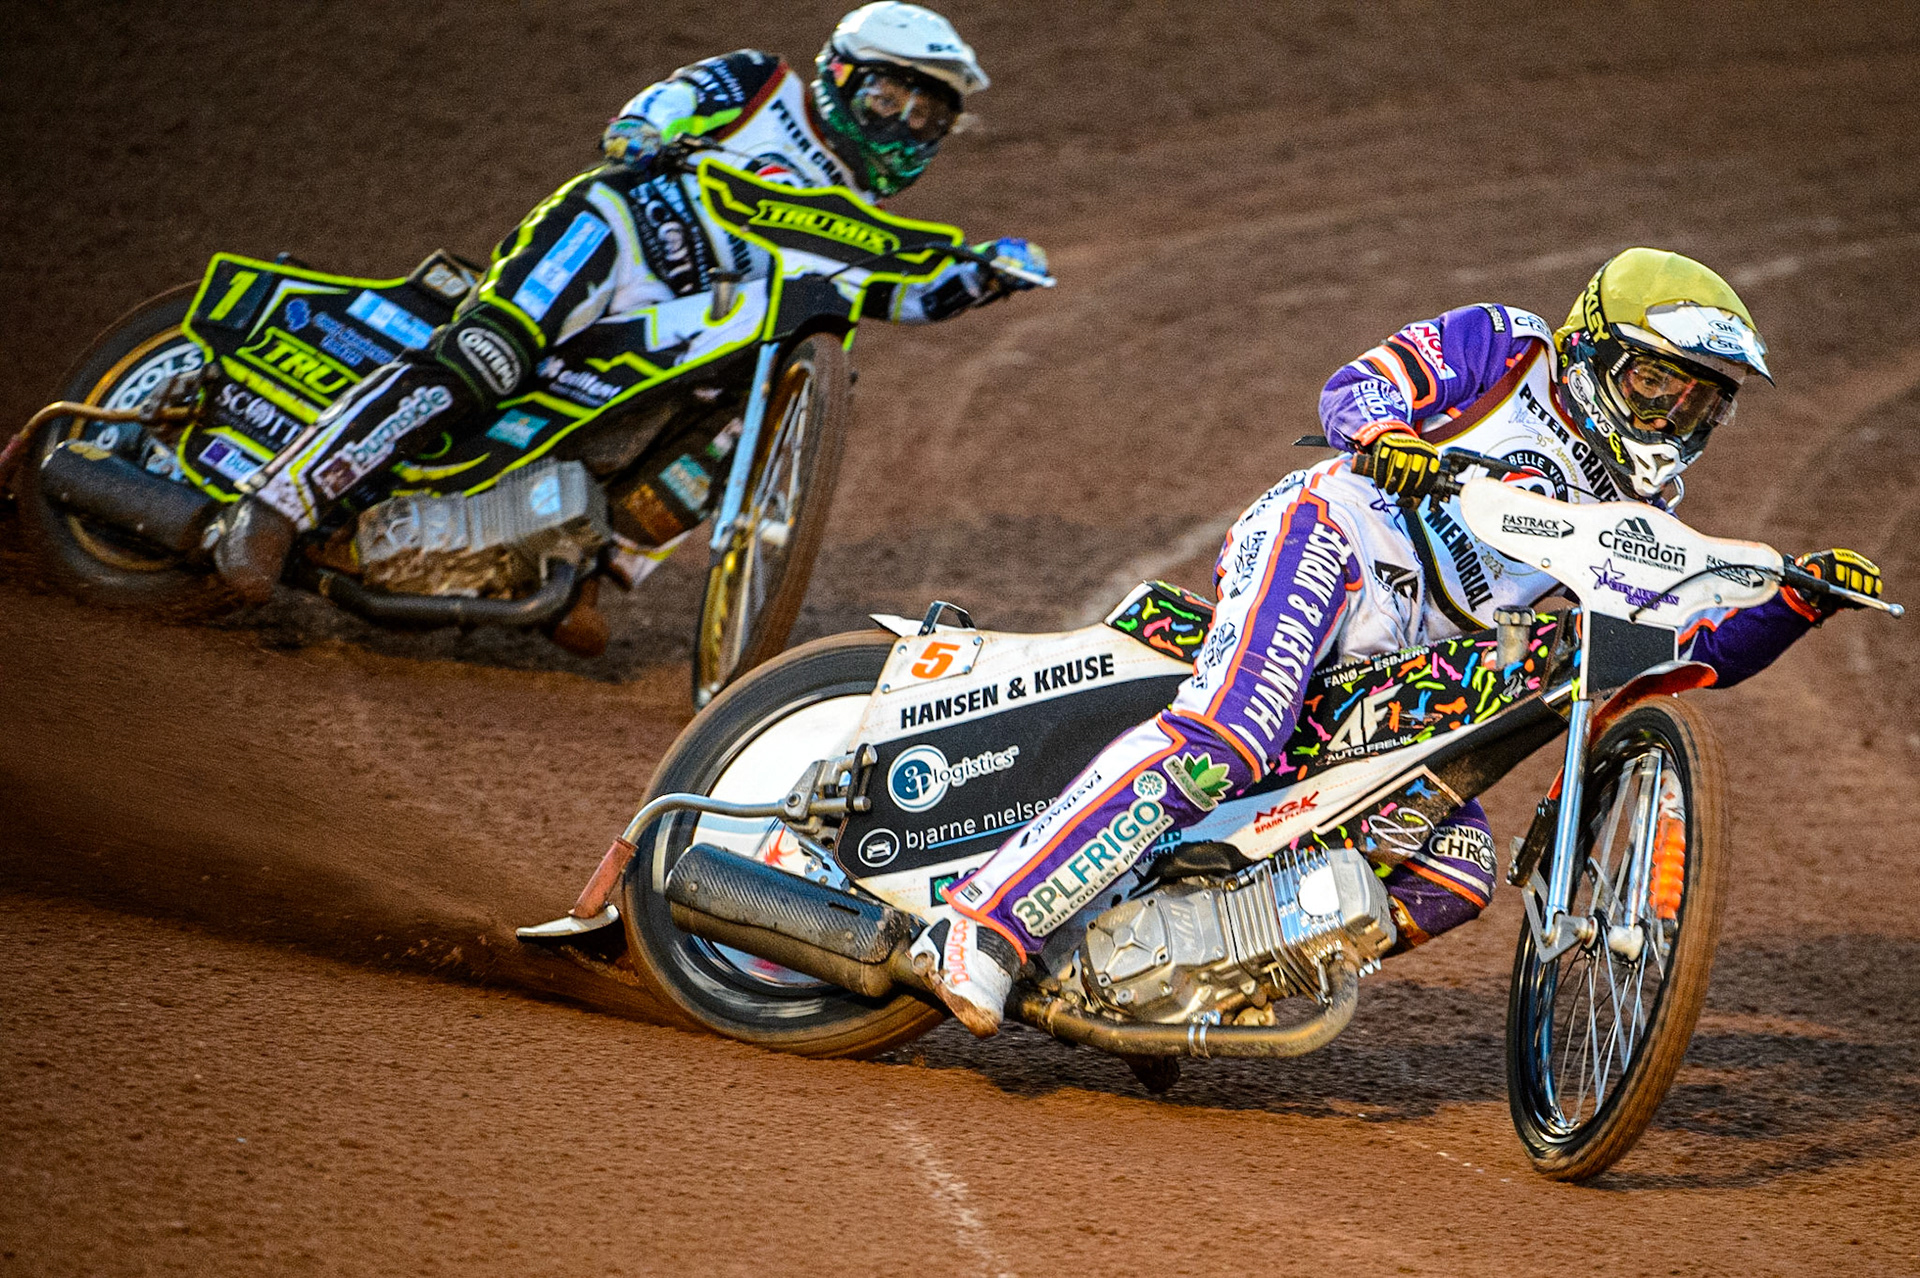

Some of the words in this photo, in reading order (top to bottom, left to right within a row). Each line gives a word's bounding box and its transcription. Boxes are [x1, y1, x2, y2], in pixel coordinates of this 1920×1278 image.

[208, 270, 259, 321] 1
[264, 340, 350, 394] TRU
[1518, 382, 1571, 445] PETER
[1508, 454, 1546, 470] BELLE
[1502, 514, 1561, 531] FASTRACK
[1293, 521, 1354, 608] KRUSE
[1425, 506, 1494, 613] MEMORIAL
[1598, 530, 1686, 567] Crendon
[1287, 592, 1324, 628] &
[910, 641, 962, 680] 5
[1242, 613, 1316, 742] HANSEN
[1323, 668, 1358, 689] FANØ
[900, 684, 999, 730] HANSEN
[1006, 677, 1028, 701] &
[1034, 653, 1115, 694] KRUSE
[1327, 746, 1365, 761] AUTO
[1253, 790, 1320, 824] NGK
[1254, 817, 1284, 836] SPARK
[905, 817, 977, 851] bjarne
[1016, 801, 1160, 929] 3PLFRIGO
[1037, 907, 1069, 935] YOUR
[1069, 866, 1120, 910] COOLEST
[1123, 817, 1171, 865] PARTNER
